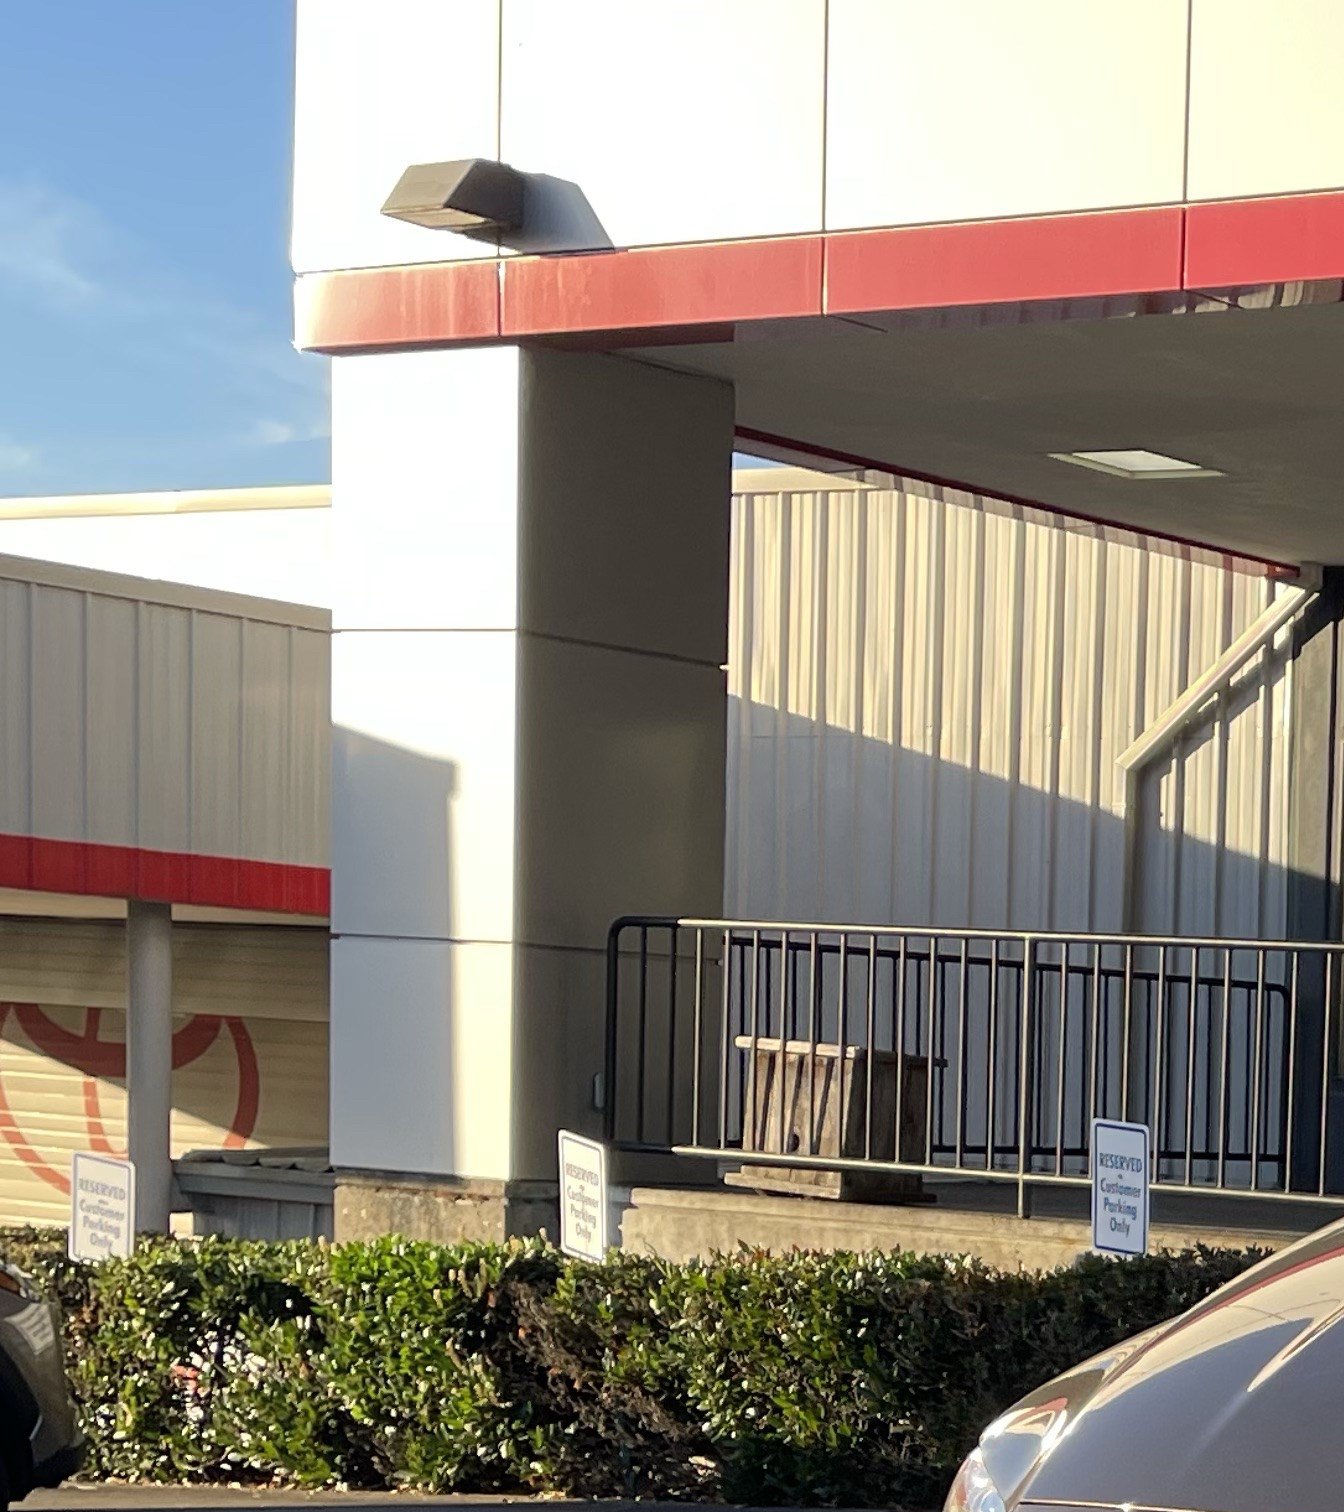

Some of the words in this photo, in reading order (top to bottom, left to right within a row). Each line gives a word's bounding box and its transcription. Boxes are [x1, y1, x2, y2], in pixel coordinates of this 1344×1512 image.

[1099, 1152, 1141, 1172] RESERVED
[565, 1162, 598, 1185] RESERVED
[79, 1177, 125, 1199] RESERVED
[567, 1184, 598, 1207] Customer
[1100, 1178, 1140, 1197] Customer
[79, 1199, 124, 1221] Customer
[570, 1203, 596, 1229] Parking
[1103, 1196, 1136, 1220] Parking
[82, 1215, 119, 1238] Parking
[575, 1222, 591, 1242] Only
[1109, 1216, 1129, 1237] Only
[89, 1232, 112, 1250] Only
